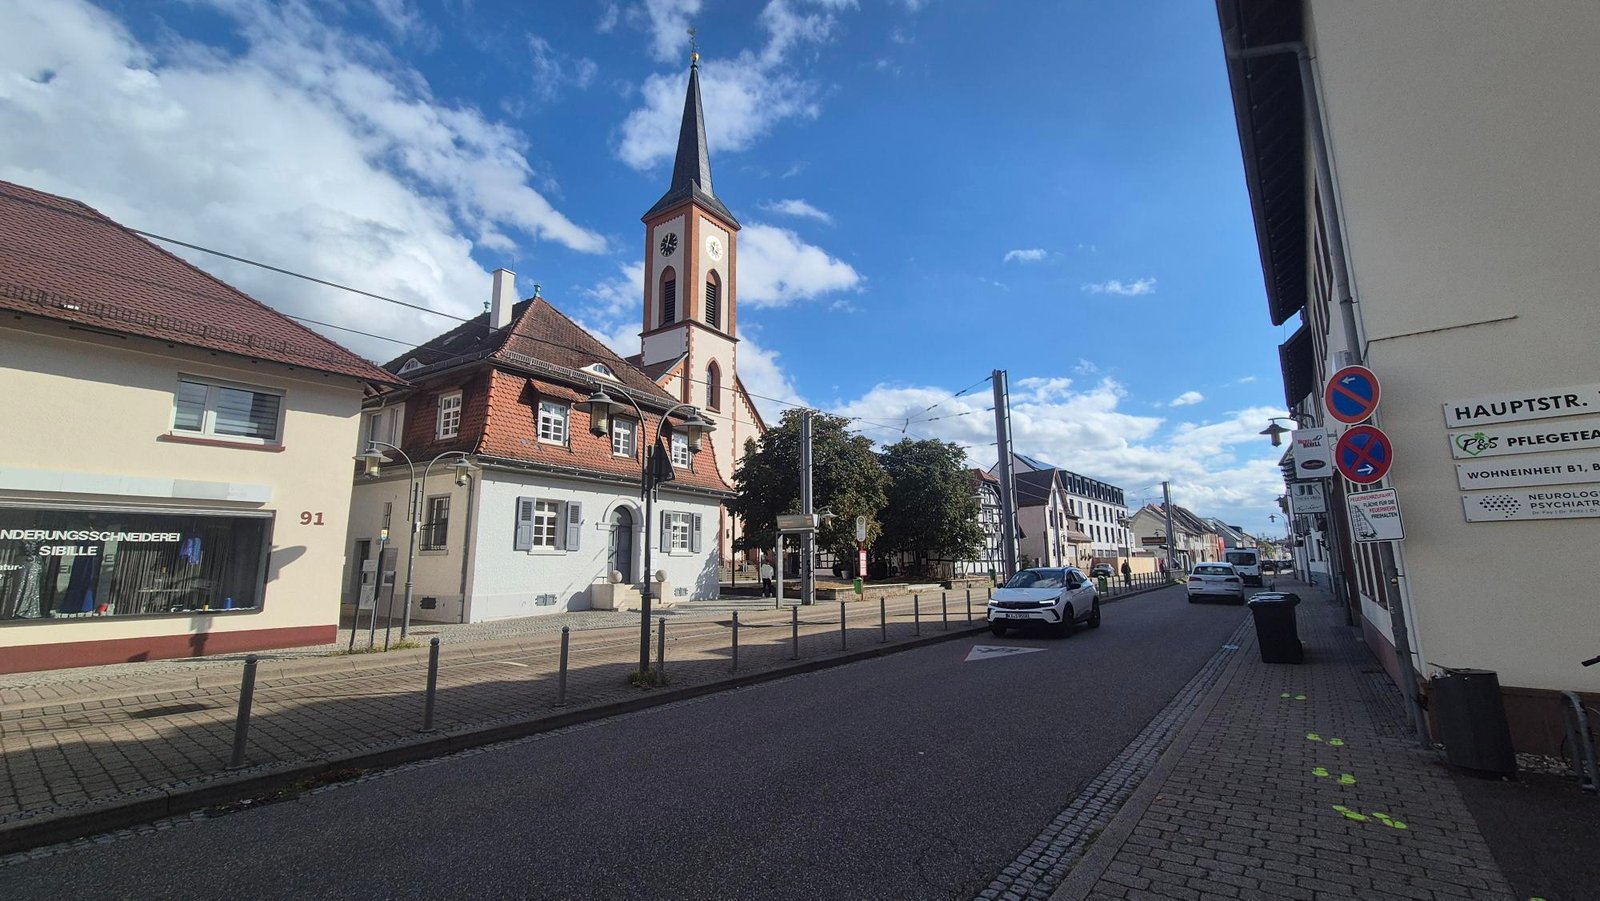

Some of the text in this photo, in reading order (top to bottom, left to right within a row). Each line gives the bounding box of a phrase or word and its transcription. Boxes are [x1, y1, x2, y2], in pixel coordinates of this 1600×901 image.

[1455, 394, 1588, 420] HAUPTSTR.
[1462, 429, 1600, 451] P&S PFLEGETEA
[1467, 465, 1562, 479] WOHNEINHEIT
[1567, 464, 1588, 473] B1,
[1528, 491, 1600, 500] NEUROLOG
[1530, 499, 1600, 509] PSYCHIATR
[300, 511, 324, 526] 91
[0, 529, 180, 542] NDERUNGSSCHNEIDEREI
[39, 545, 98, 556] SIBILLE
